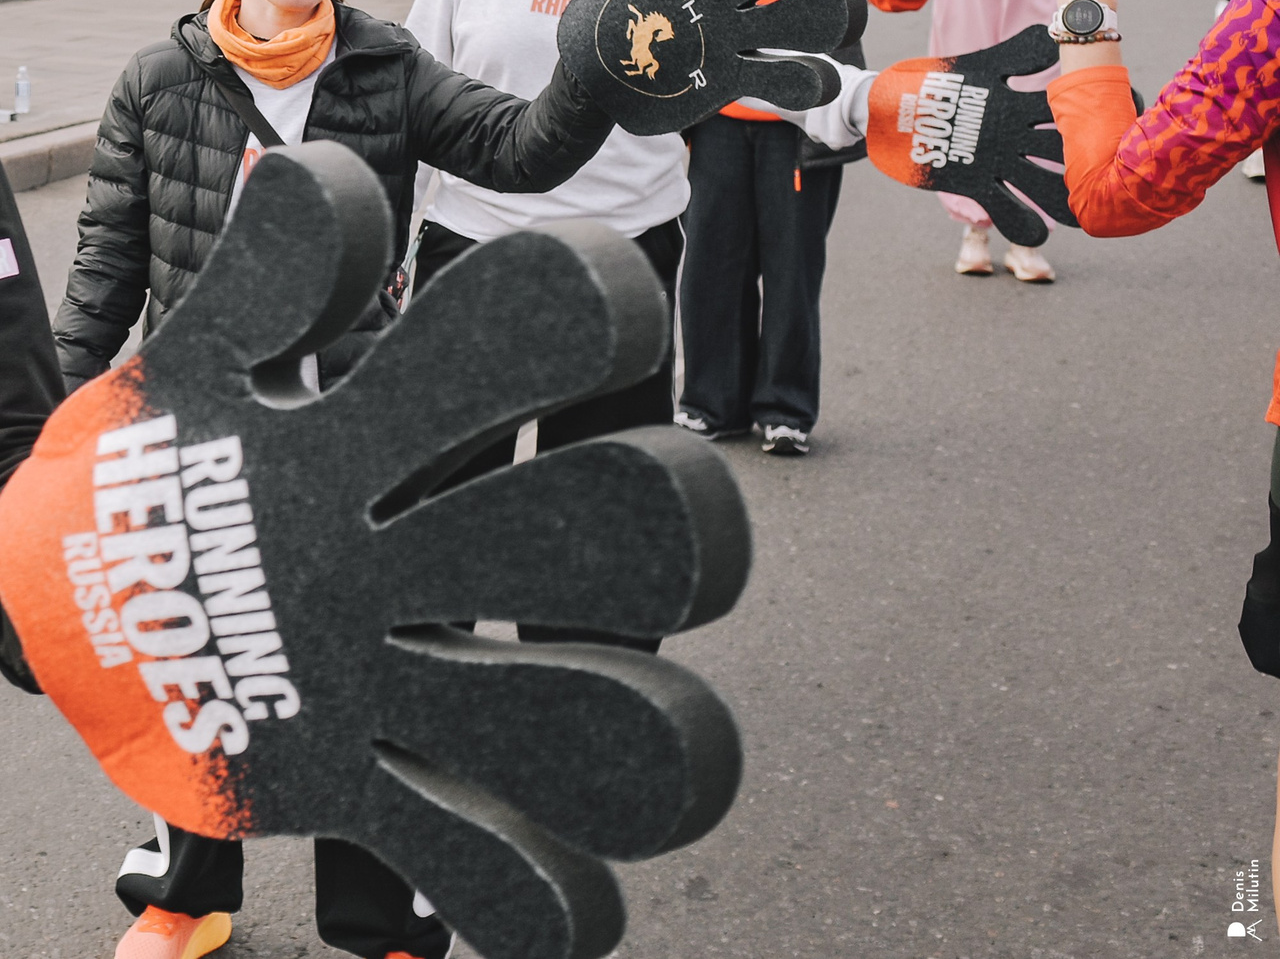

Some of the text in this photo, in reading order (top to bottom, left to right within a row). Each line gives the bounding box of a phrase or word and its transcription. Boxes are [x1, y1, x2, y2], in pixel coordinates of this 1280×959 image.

[910, 71, 964, 169] HEROES
[947, 84, 989, 165] RUNNING
[62, 531, 133, 669] RUSSIA
[92, 413, 250, 756] HEROES
[179, 435, 301, 721] RUNNING
